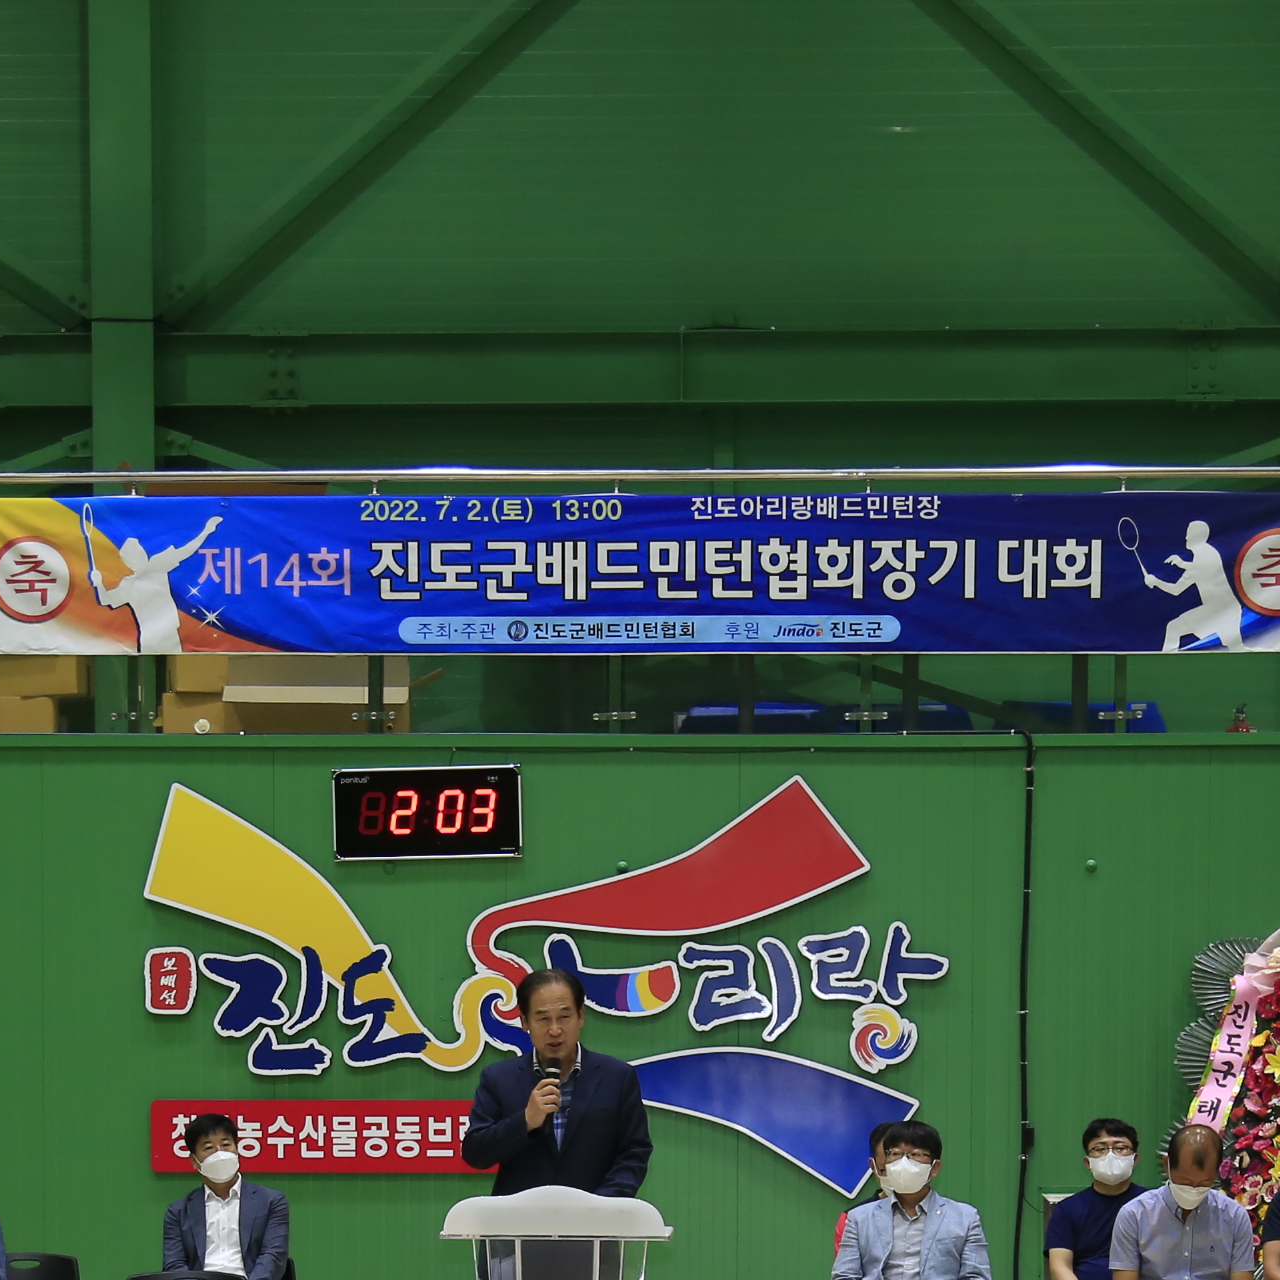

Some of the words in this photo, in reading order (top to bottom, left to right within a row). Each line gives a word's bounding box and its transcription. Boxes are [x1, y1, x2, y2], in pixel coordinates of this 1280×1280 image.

[360, 499, 426, 522] 2022.
[436, 499, 458, 522] 7.
[552, 498, 622, 521] 13:00
[690, 495, 941, 520] 진도아리랑배드민턴장
[4, 552, 58, 606] 축
[198, 546, 352, 598] 제14회
[370, 537, 977, 601] 진도군배드민턴협회장기
[997, 537, 1104, 600] 대회
[416, 622, 496, 640] 주최·주관
[533, 621, 696, 640] 진도군배드민턴협회
[724, 622, 760, 640] 후원
[773, 624, 819, 638] Jindo
[829, 621, 884, 638] 진도군
[159, 957, 178, 1005] 보배섬
[202, 945, 432, 1071] 진도
[1211, 1000, 1251, 1089] 진도군
[171, 1113, 471, 1159] 청농수산물공동브
